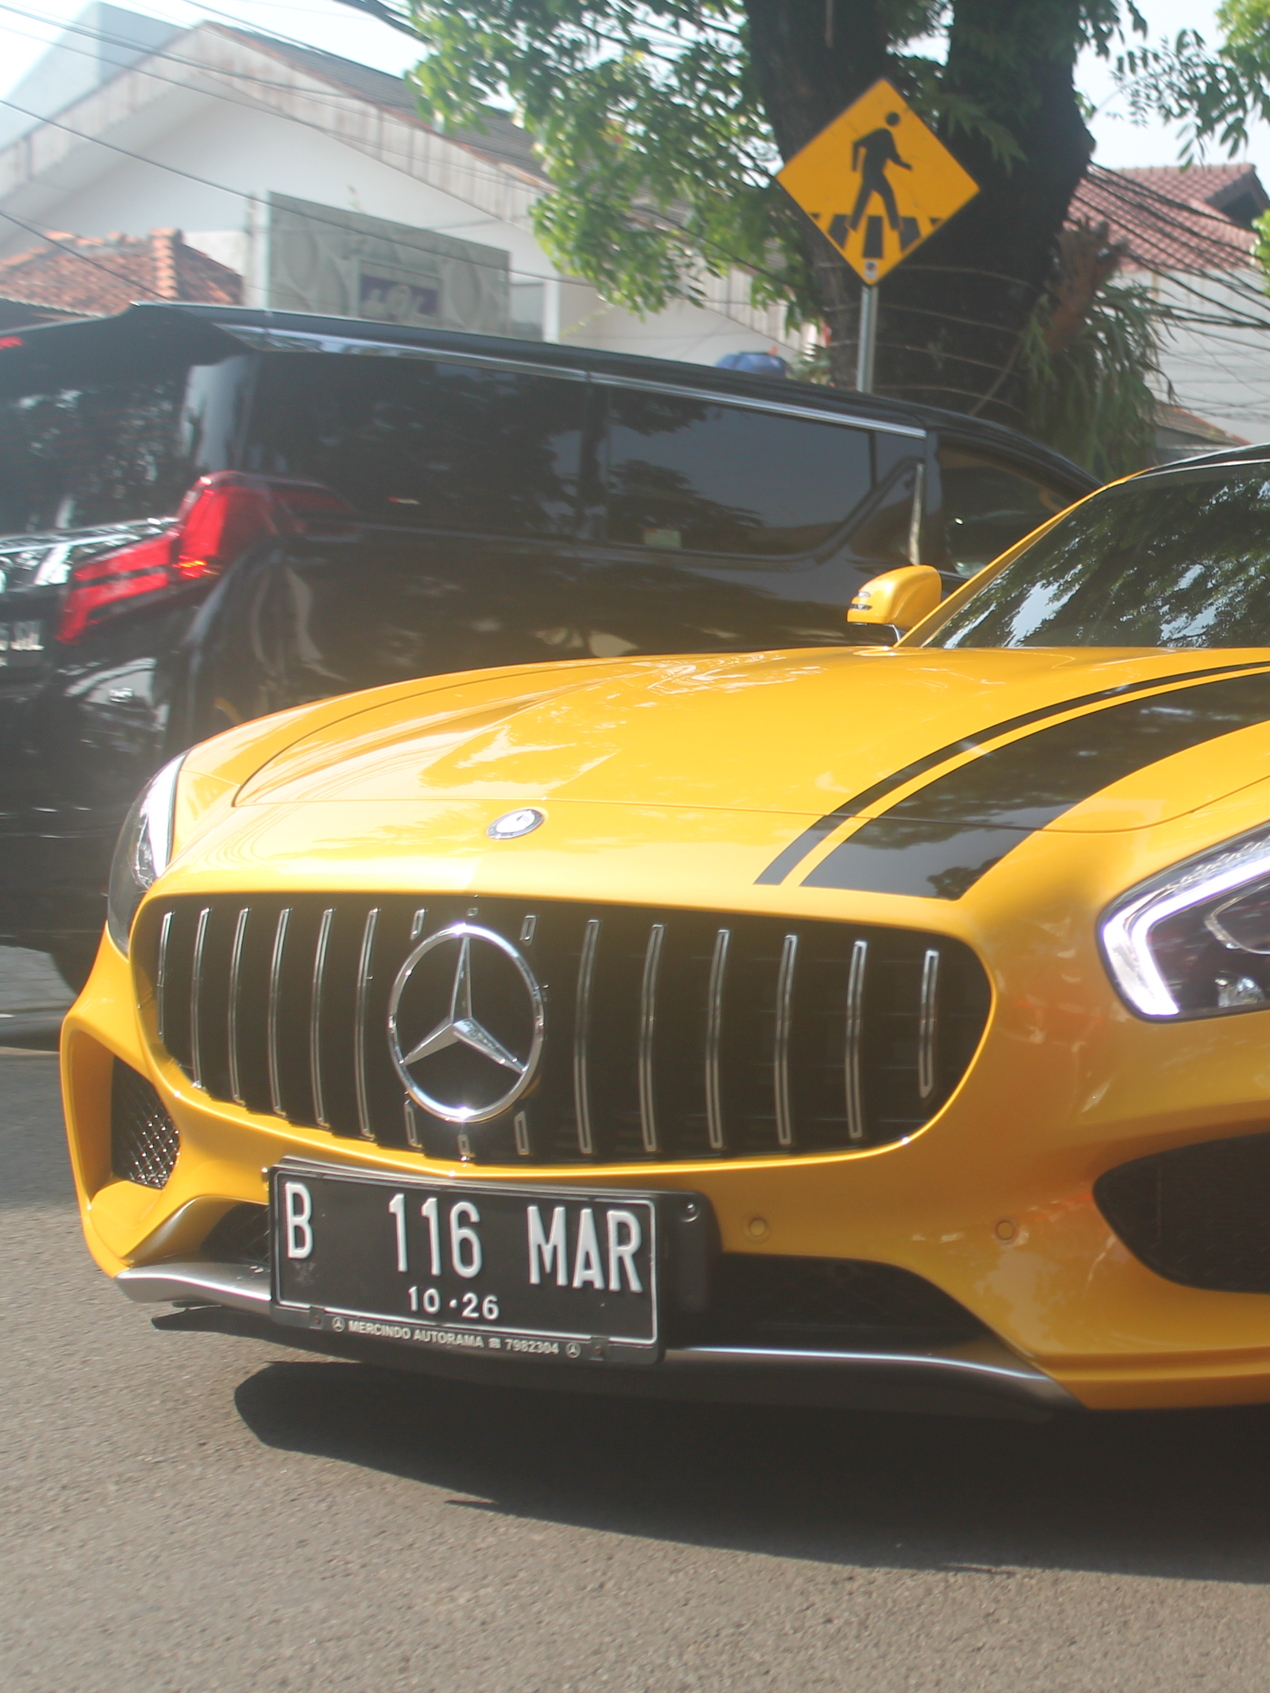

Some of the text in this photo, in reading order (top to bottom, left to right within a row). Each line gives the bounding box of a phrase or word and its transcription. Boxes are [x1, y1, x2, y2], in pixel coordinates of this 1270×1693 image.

[284, 1181, 643, 1293] B 116 MAR
[348, 1320, 411, 1340] MERCINDO
[412, 1329, 485, 1349] AUTORAMA
